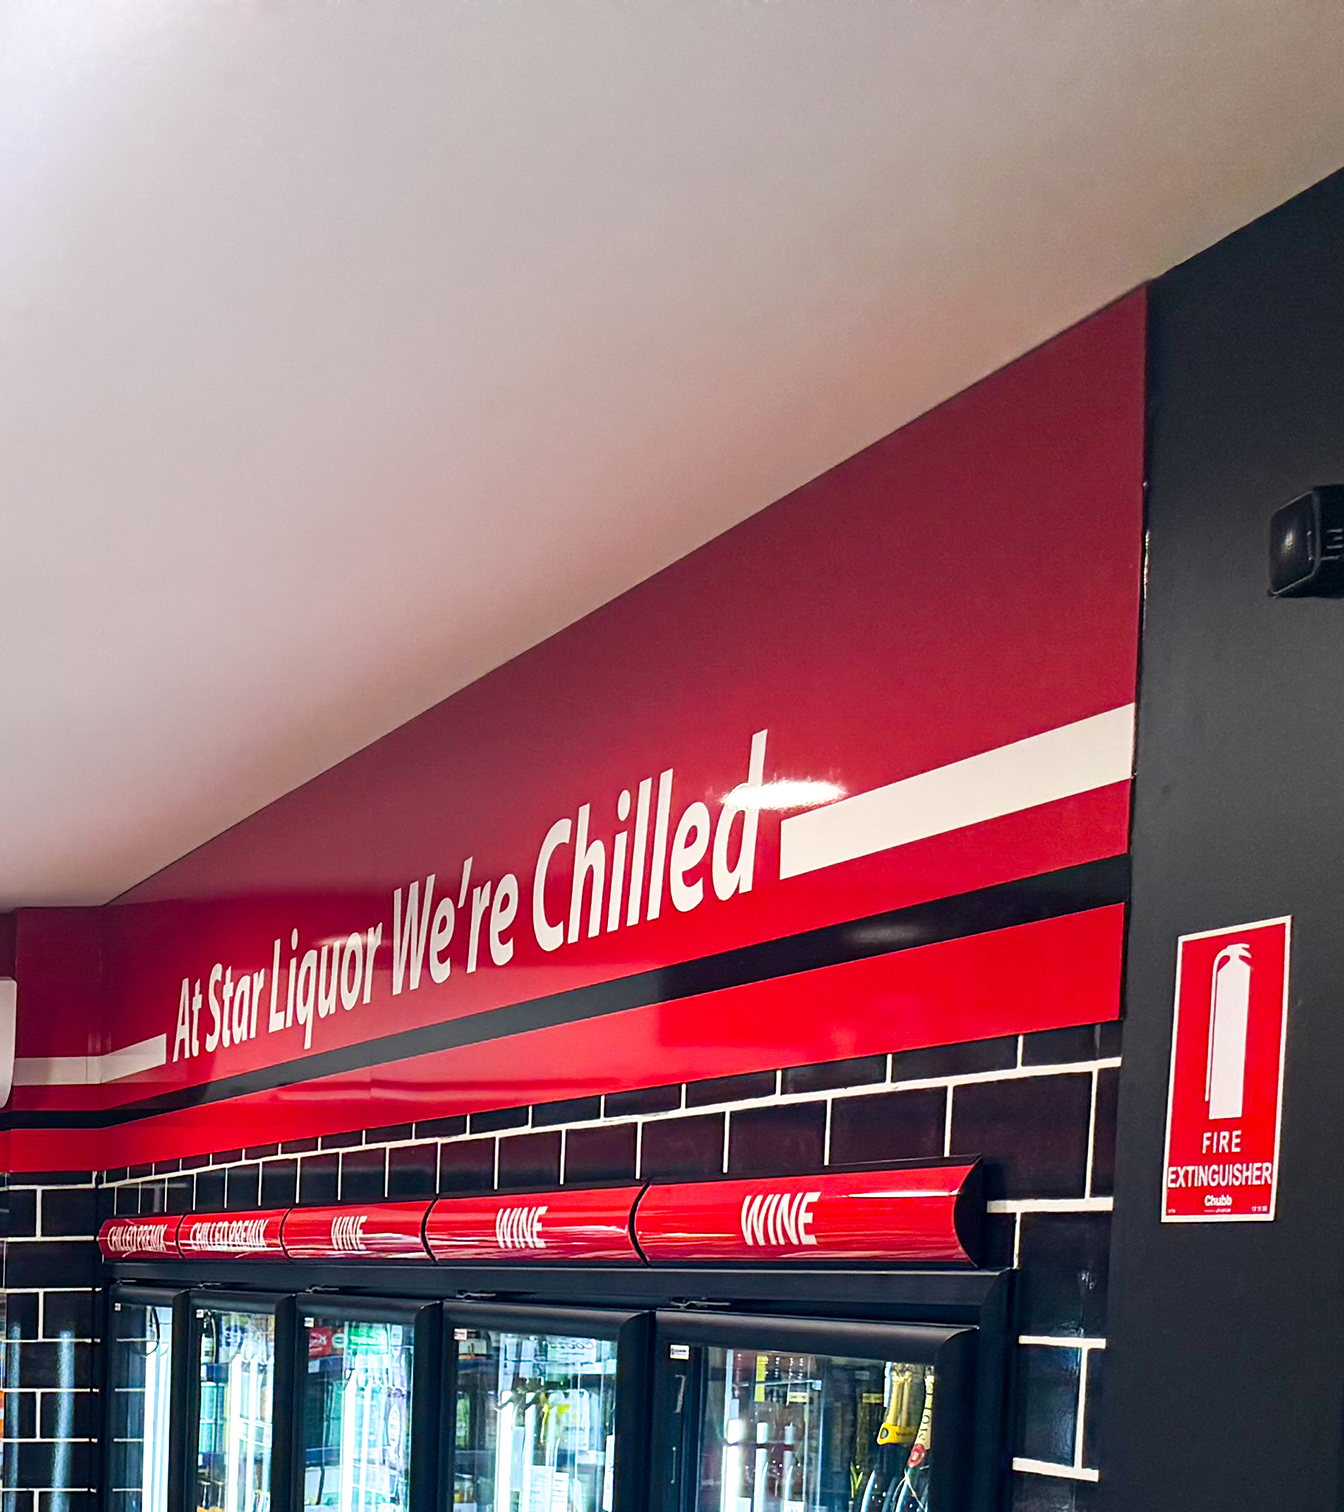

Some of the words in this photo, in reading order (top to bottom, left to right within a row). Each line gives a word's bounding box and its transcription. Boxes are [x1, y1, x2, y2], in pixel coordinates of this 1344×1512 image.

[171, 977, 202, 1063] At
[206, 963, 264, 1053] Star
[268, 922, 383, 1050] Liquor
[392, 856, 518, 996] We're
[532, 729, 767, 952] Chilled
[1202, 1131, 1241, 1153] FIRE
[1167, 1162, 1272, 1188] EXTINGUISHER
[1205, 1194, 1232, 1207] Chubb
[331, 1216, 367, 1250] WINE
[495, 1206, 547, 1249] WINE
[741, 1191, 822, 1246] WINE
